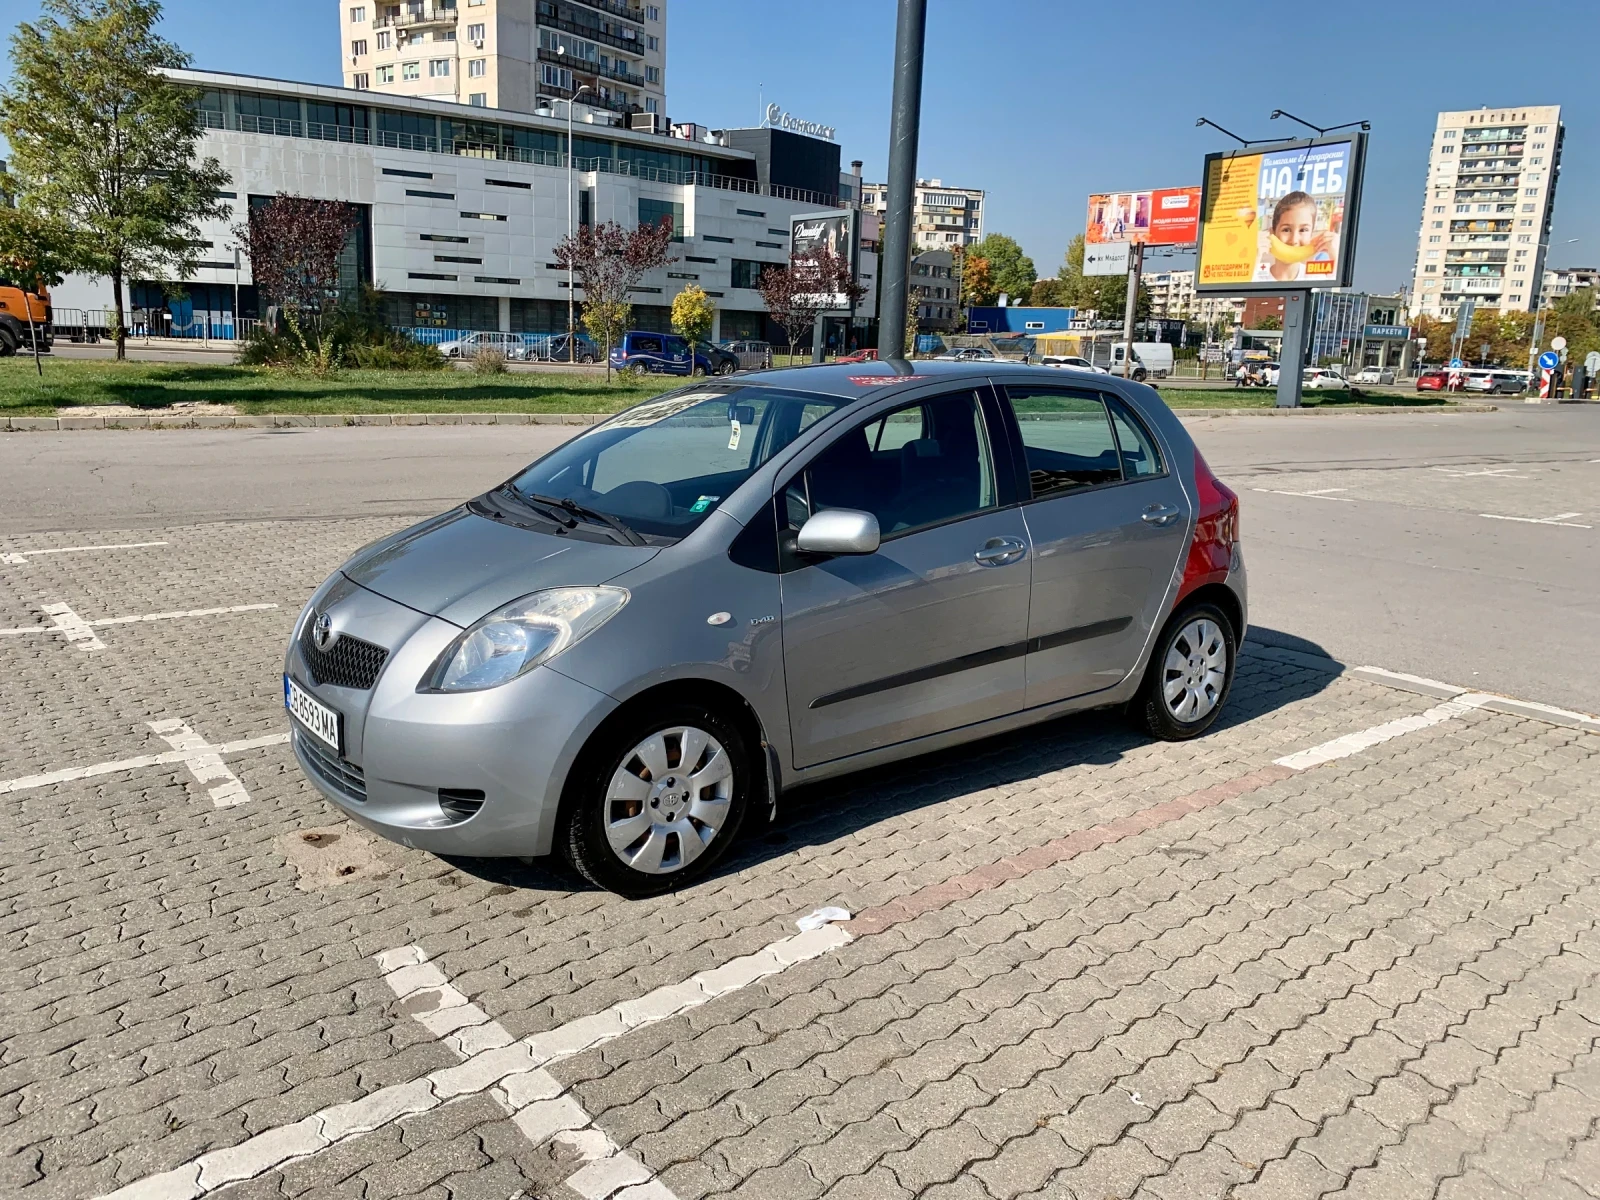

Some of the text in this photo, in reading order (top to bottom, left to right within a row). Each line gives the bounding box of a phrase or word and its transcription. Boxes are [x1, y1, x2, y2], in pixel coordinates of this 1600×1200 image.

[1261, 166, 1292, 199] НА
[1298, 160, 1343, 195] ТЕБ
[795, 222, 826, 240] Davidoff
[1307, 262, 1332, 273] BILLA
[1148, 321, 1182, 330] BEER BOX
[1371, 327, 1403, 335] ПАРКЕТИ
[299, 693, 321, 732] 8593
[321, 710, 336, 744] MA
